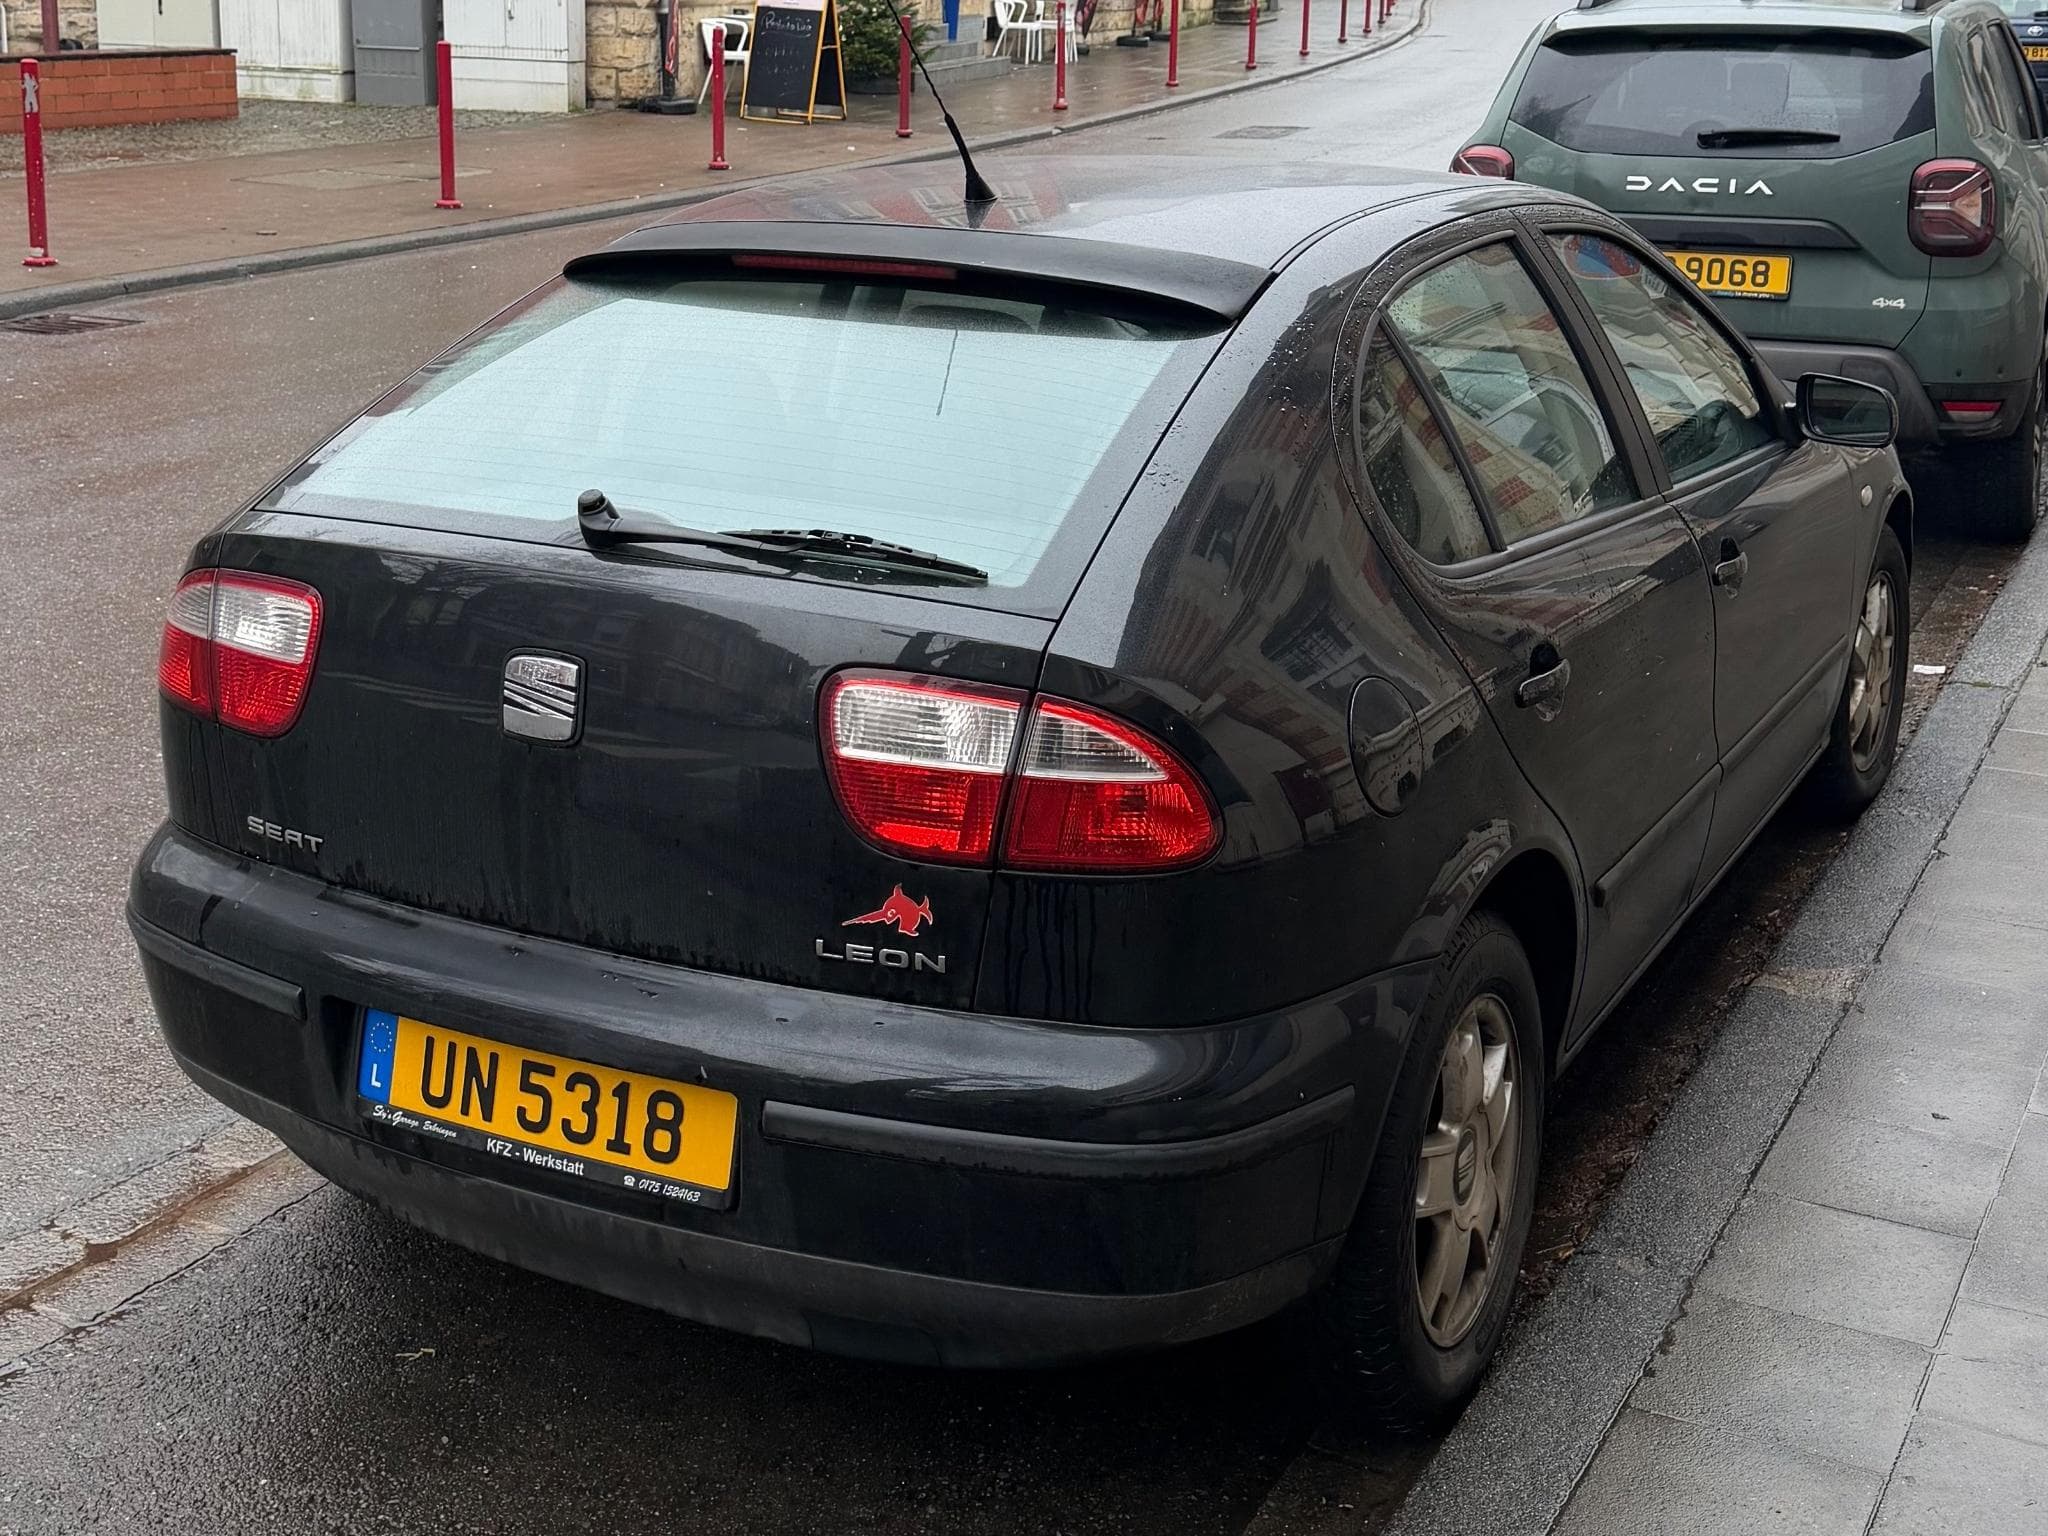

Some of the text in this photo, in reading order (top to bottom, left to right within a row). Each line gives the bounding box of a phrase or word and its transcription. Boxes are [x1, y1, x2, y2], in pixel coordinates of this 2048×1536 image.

[1625, 175, 1774, 195] DACIA
[1685, 256, 1771, 288] 9068
[1872, 297, 1906, 309] 4x4
[247, 815, 324, 853] SEAT
[815, 938, 946, 974] LEON
[370, 1062, 382, 1089] L
[420, 1035, 685, 1164] UN 5318
[486, 1137, 513, 1158] KFZ
[522, 1147, 585, 1176] Werkstatt
[638, 1179, 662, 1193] 0175
